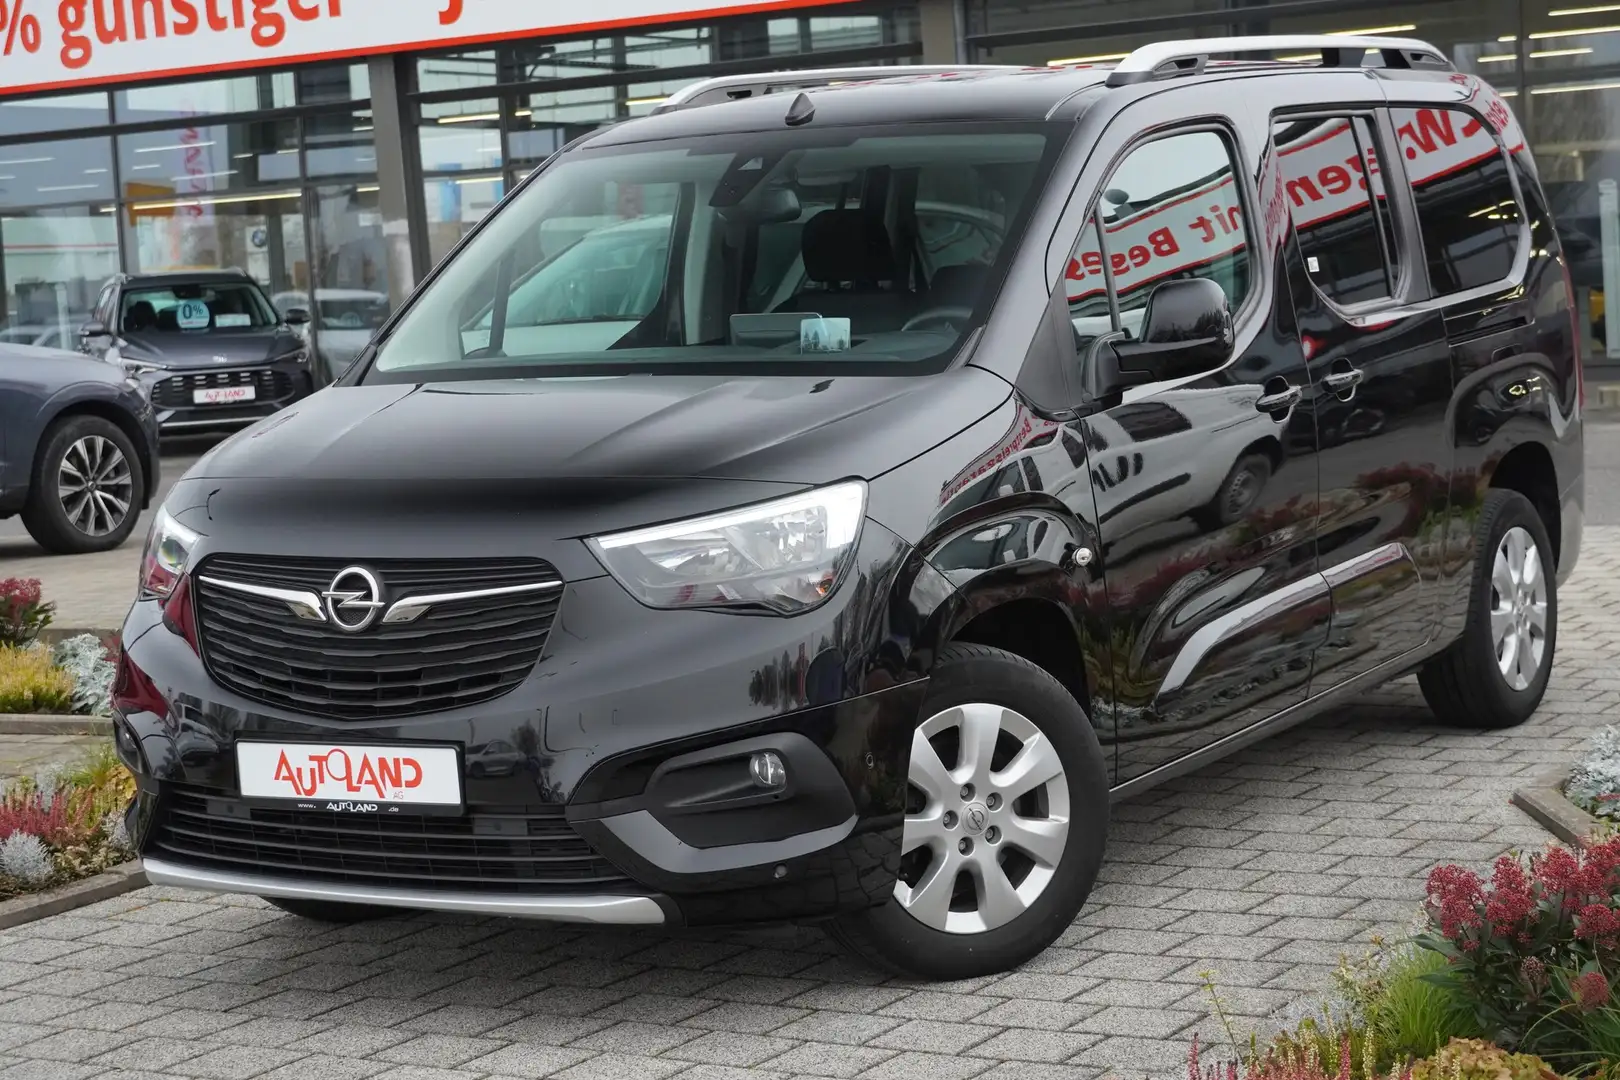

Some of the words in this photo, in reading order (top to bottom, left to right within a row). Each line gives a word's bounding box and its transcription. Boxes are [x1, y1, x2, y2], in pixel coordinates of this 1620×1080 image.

[182, 303, 204, 320] 0%
[274, 748, 423, 798] AUTOLAND
[392, 790, 404, 800] AG
[326, 801, 378, 813] AUTOLAND
